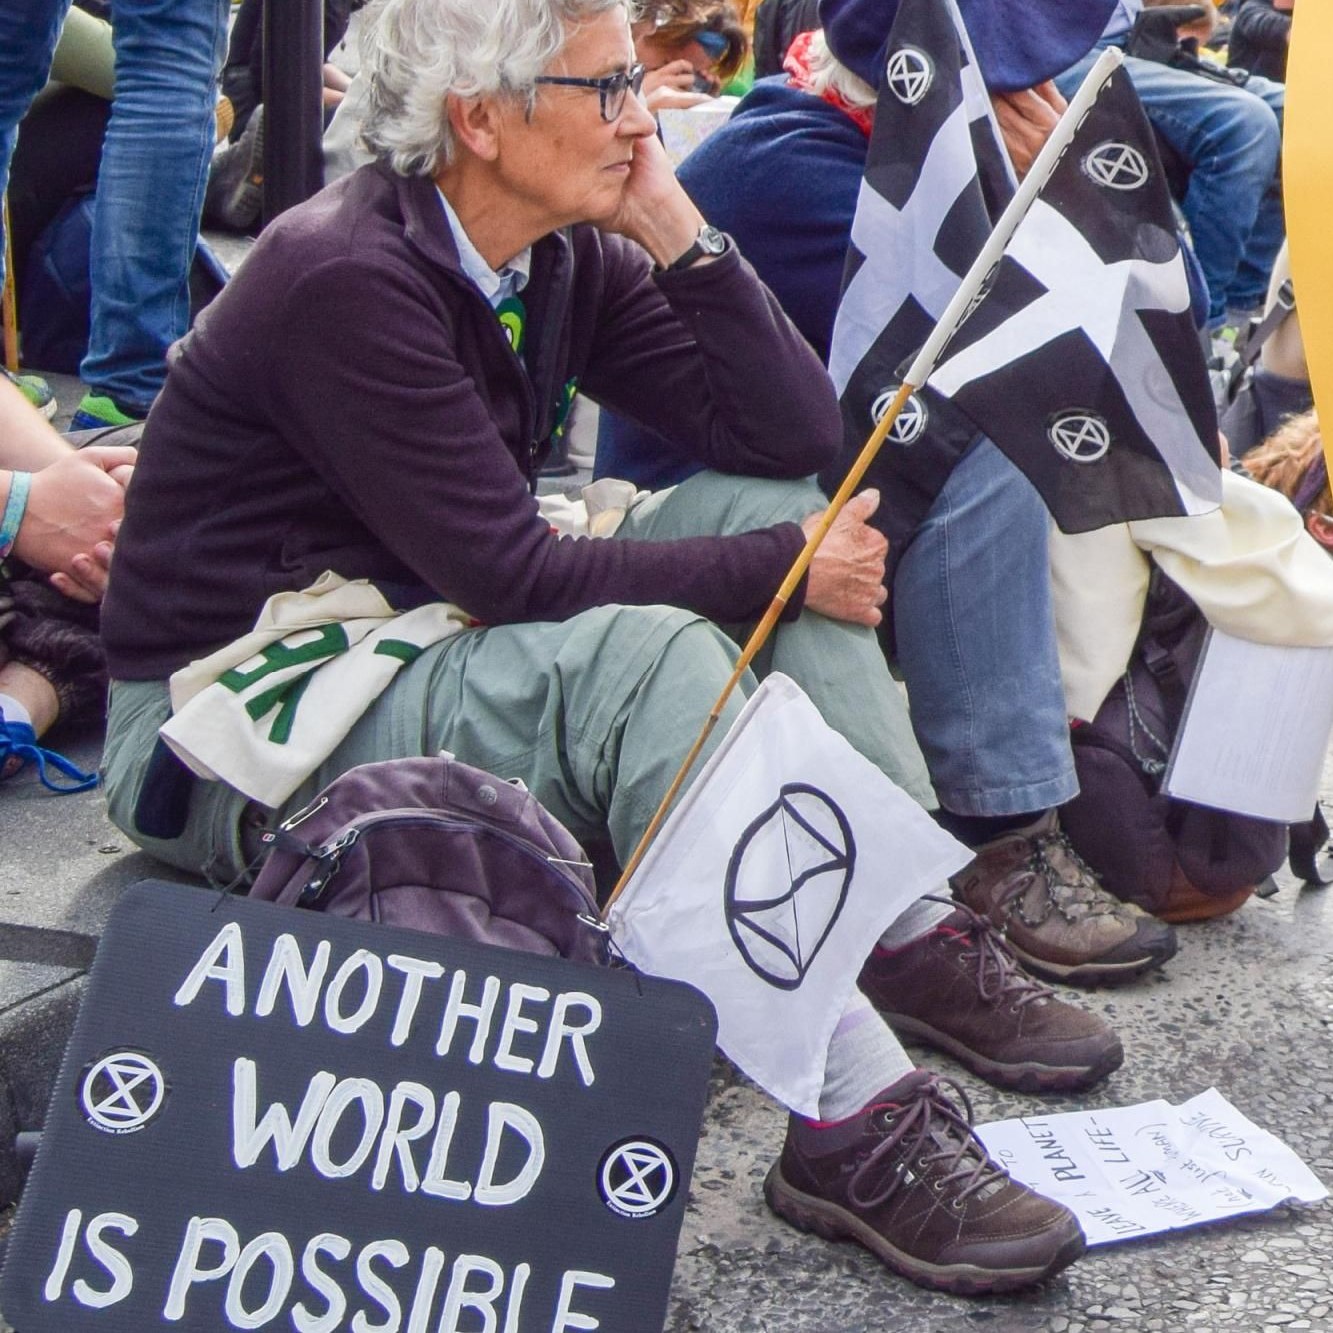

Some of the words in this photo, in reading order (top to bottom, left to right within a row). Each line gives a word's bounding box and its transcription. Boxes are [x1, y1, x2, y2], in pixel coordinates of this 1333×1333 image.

[174, 922, 603, 1087] ANOTHER
[233, 1057, 546, 1206] WORLD
[1019, 1117, 1086, 1183] PLANET
[1120, 1169, 1161, 1197] ALL
[45, 1209, 140, 1309] IS
[164, 1216, 616, 1333] POSSIBLE
